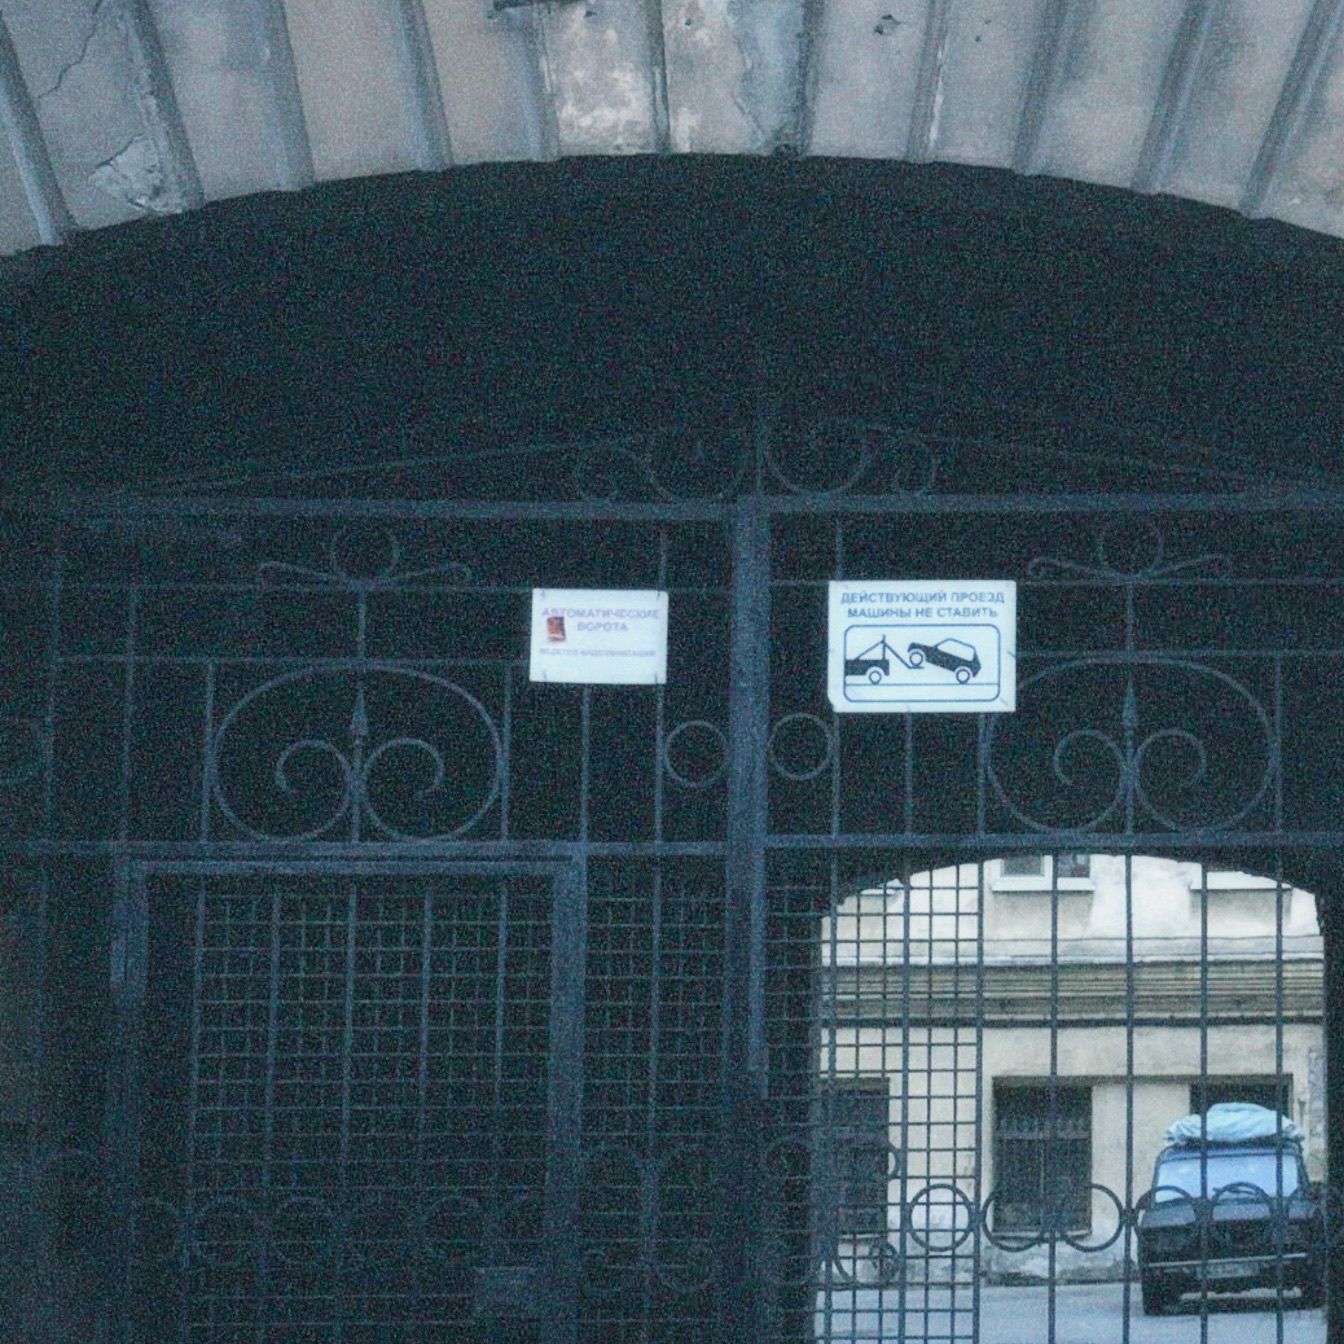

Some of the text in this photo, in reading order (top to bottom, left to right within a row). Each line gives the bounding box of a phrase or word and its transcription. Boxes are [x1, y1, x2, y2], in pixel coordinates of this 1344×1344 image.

[841, 590, 1005, 604] ДЕЙСТВУЮЩИЙ ПРОЕЗД
[847, 607, 998, 618] МАШИНЫ НЕ СТАВИТЬ
